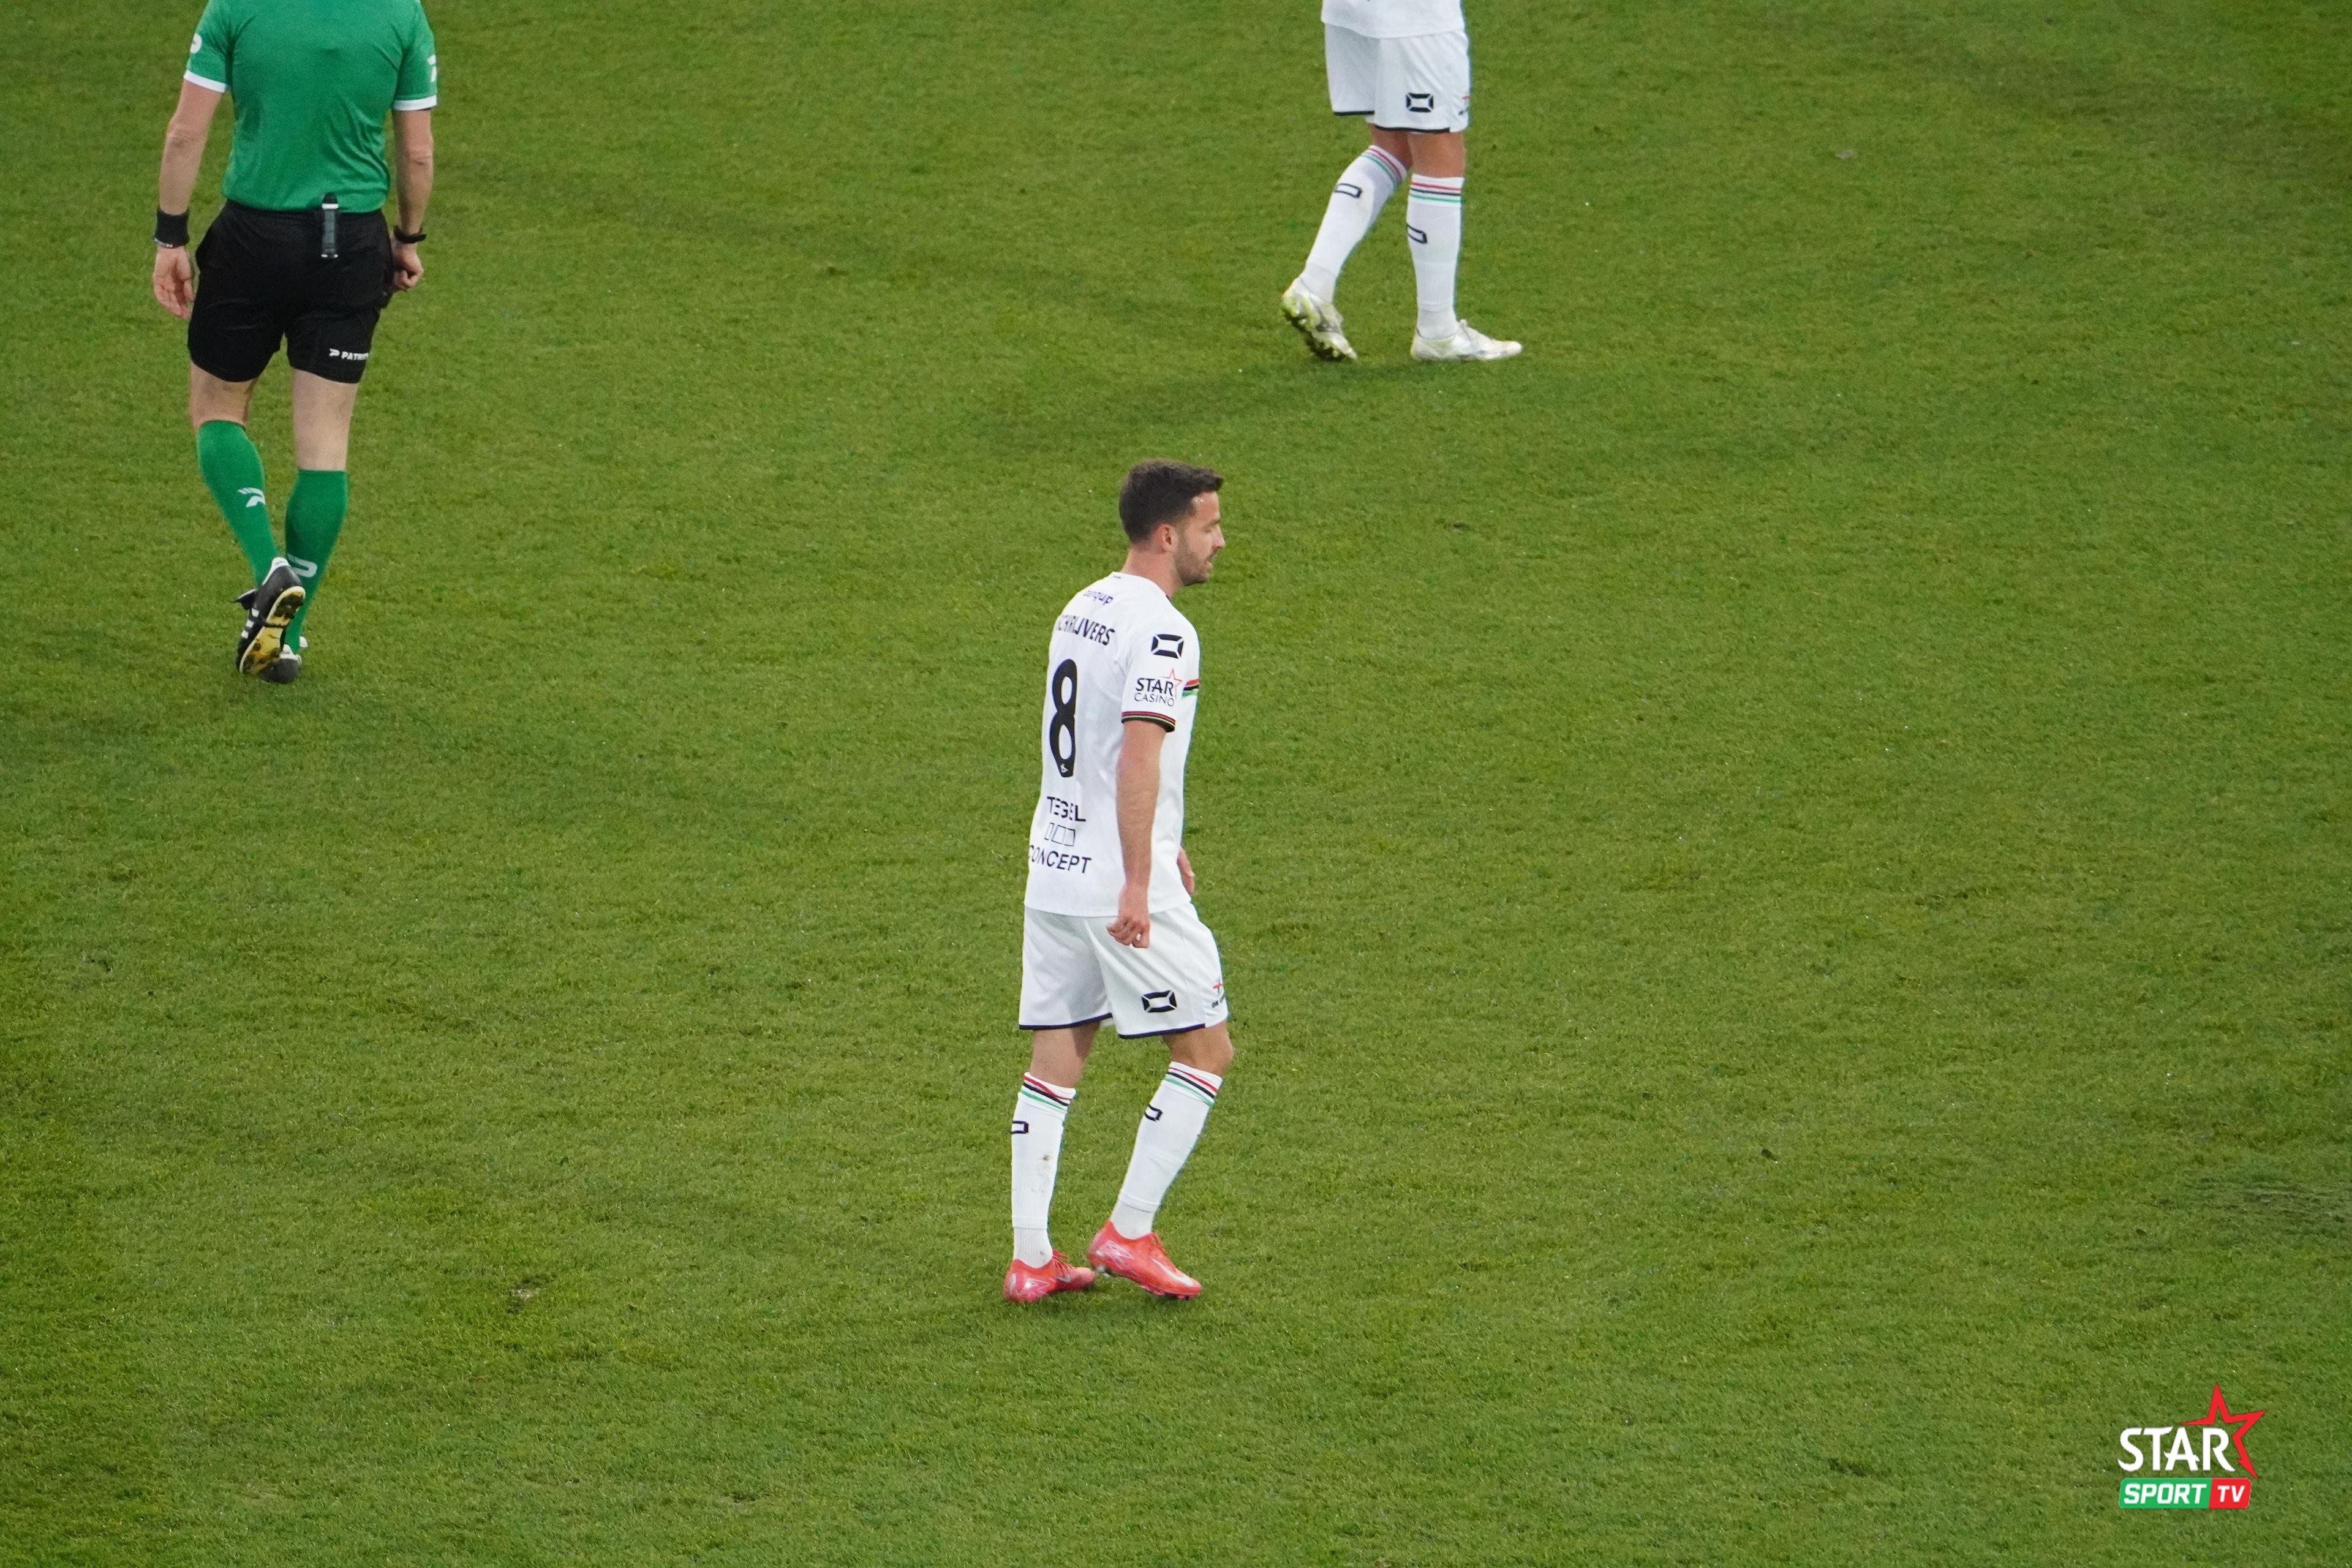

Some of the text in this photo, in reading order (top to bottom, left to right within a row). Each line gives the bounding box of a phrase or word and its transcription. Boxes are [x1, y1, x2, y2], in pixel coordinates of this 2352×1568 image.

[1136, 678, 1174, 696] STAR
[1134, 693, 1175, 706] CASINO
[1049, 658, 1077, 777] 8
[1047, 796, 1086, 821] TEGEL
